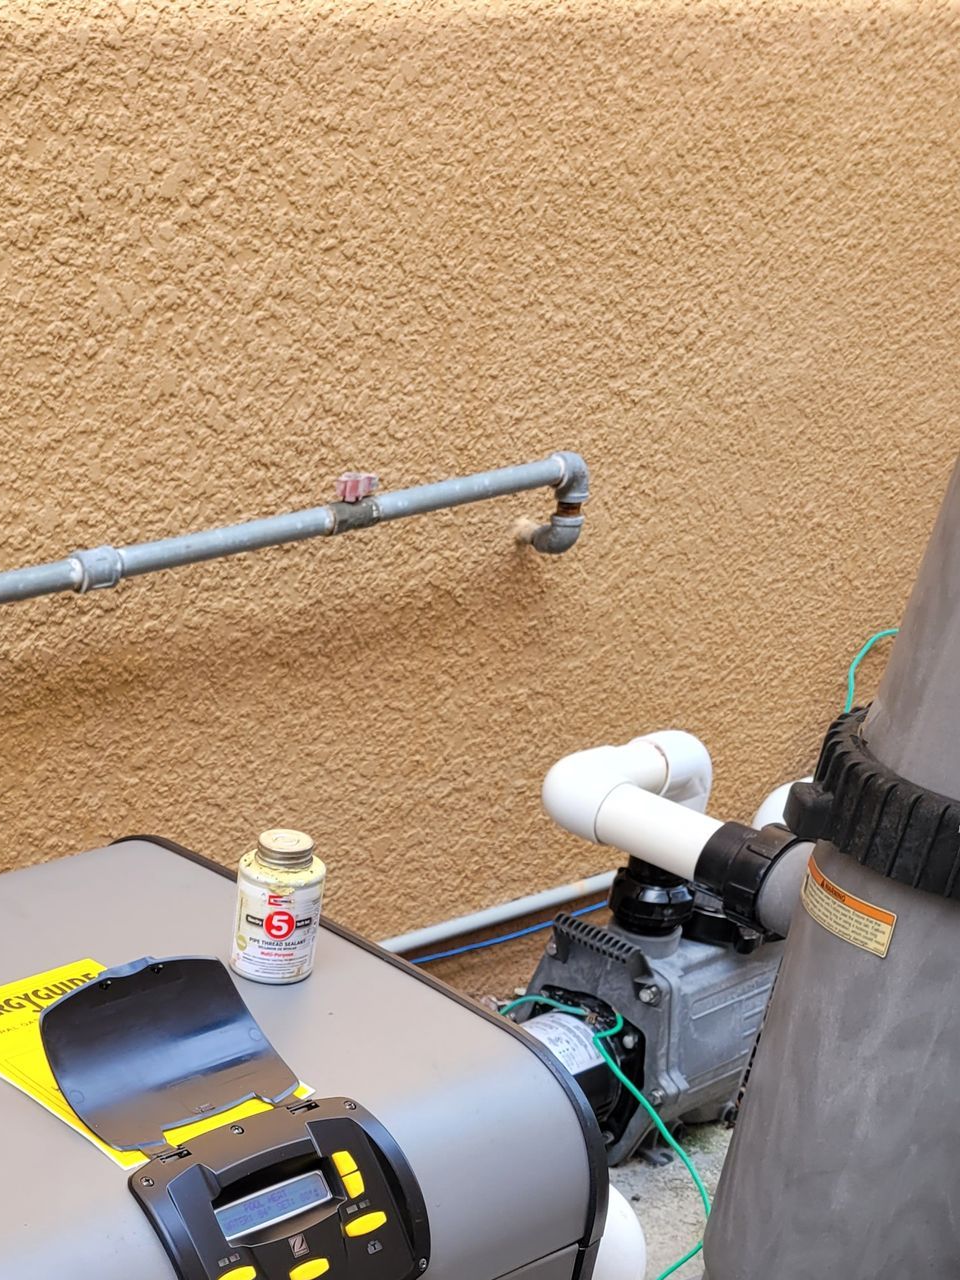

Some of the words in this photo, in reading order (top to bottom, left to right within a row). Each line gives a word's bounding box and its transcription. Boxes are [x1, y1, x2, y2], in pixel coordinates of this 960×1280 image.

[825, 883, 845, 903] WARNING
[271, 915, 289, 935] 5
[285, 938, 306, 947] SEALANT
